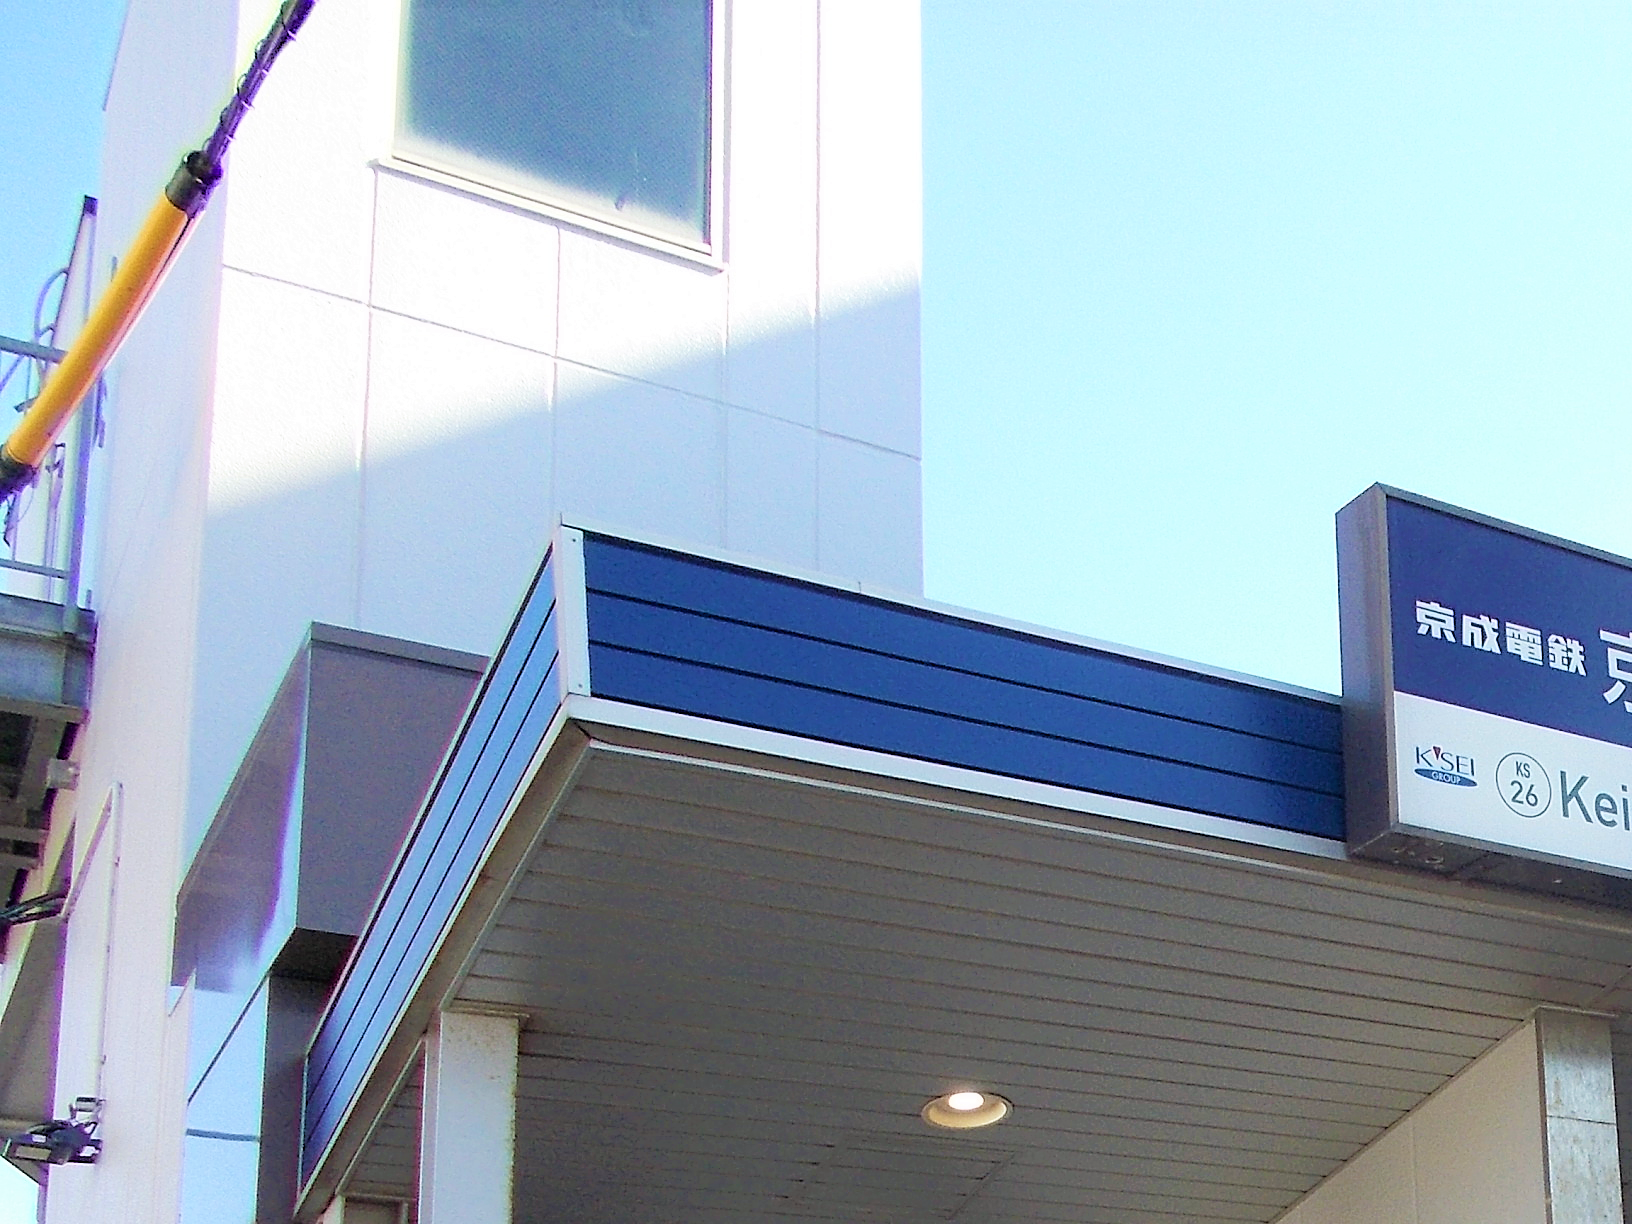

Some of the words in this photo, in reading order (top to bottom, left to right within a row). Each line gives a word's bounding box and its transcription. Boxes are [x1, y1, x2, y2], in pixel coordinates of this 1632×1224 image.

[1415, 600, 1587, 676] 京成電鉄
[1431, 772, 1461, 785] GROUP
[1515, 761, 1531, 779] KS
[1510, 780, 1538, 807] 26
